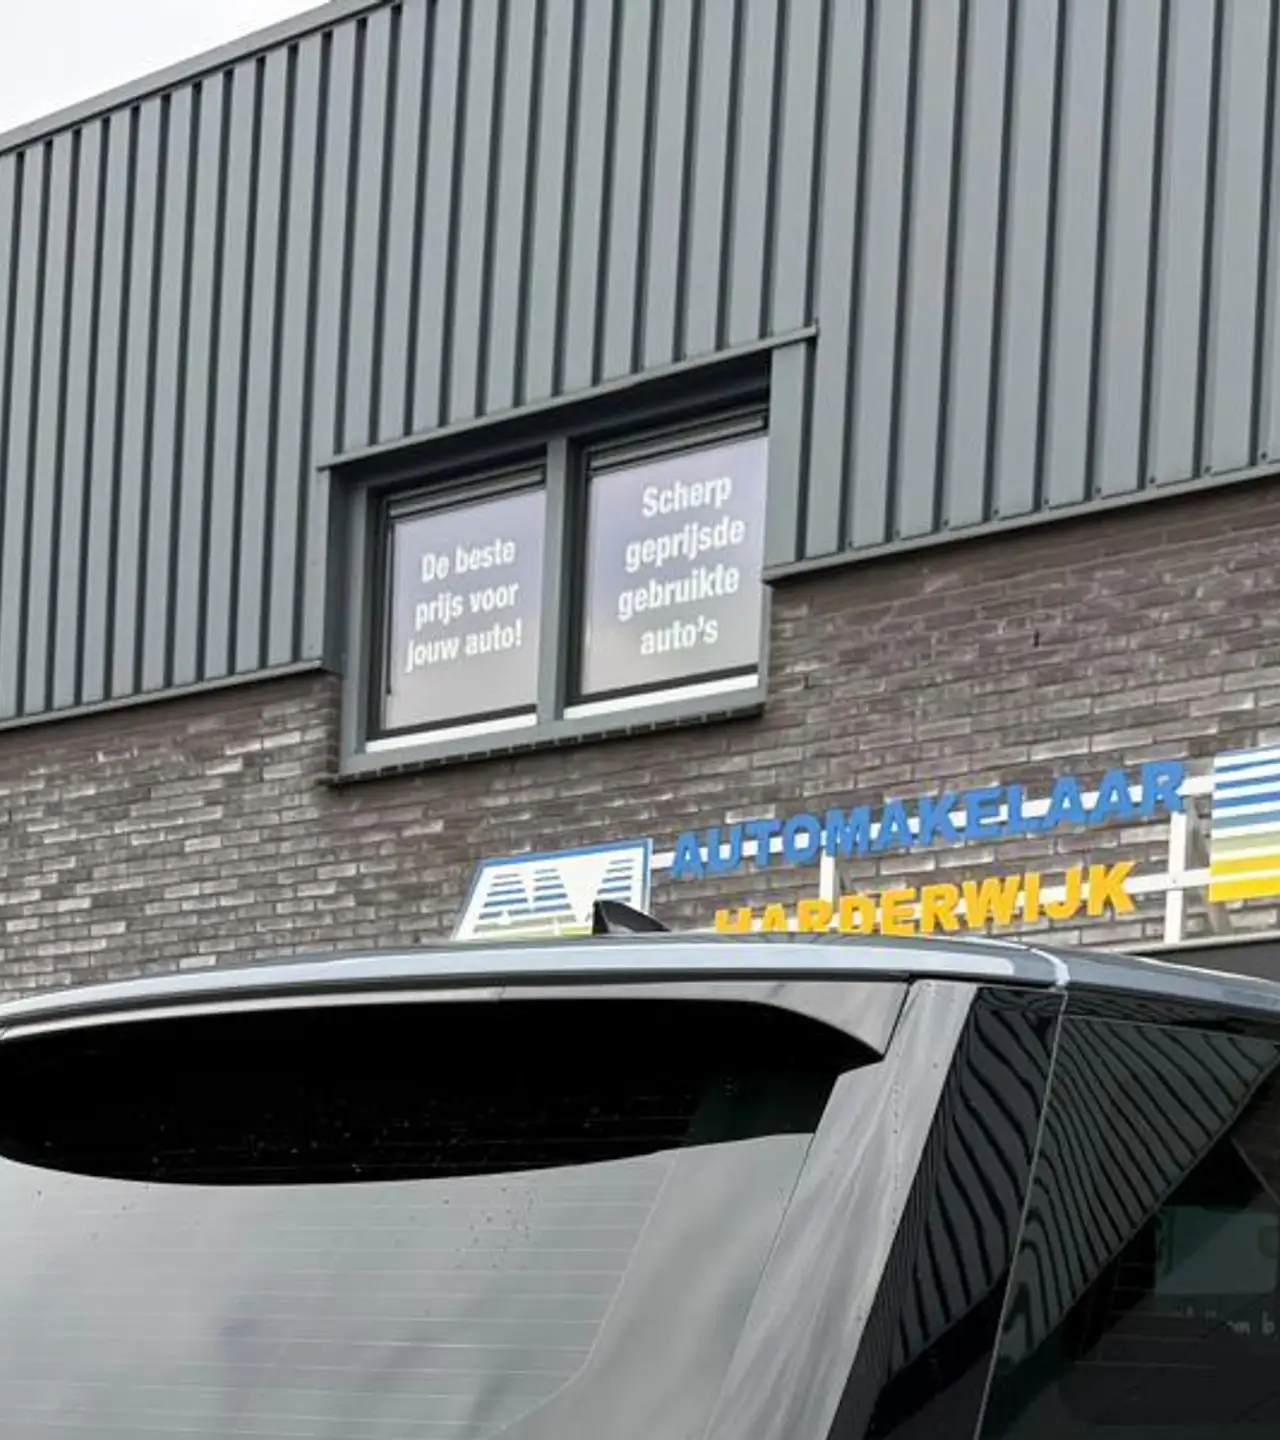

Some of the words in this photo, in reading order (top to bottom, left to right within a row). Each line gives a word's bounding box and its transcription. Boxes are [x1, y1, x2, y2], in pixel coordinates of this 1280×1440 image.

[642, 476, 733, 520] Scherp
[421, 550, 450, 583] De
[455, 537, 517, 573] beste
[625, 517, 746, 574] geprijsde
[414, 594, 464, 632] prijs
[469, 580, 519, 614] voor
[618, 563, 739, 622] gebruikte
[406, 637, 460, 674] jouw
[465, 618, 522, 653] auto!
[639, 617, 719, 657] auto's
[670, 762, 1187, 880] AUTOMAKELAAR
